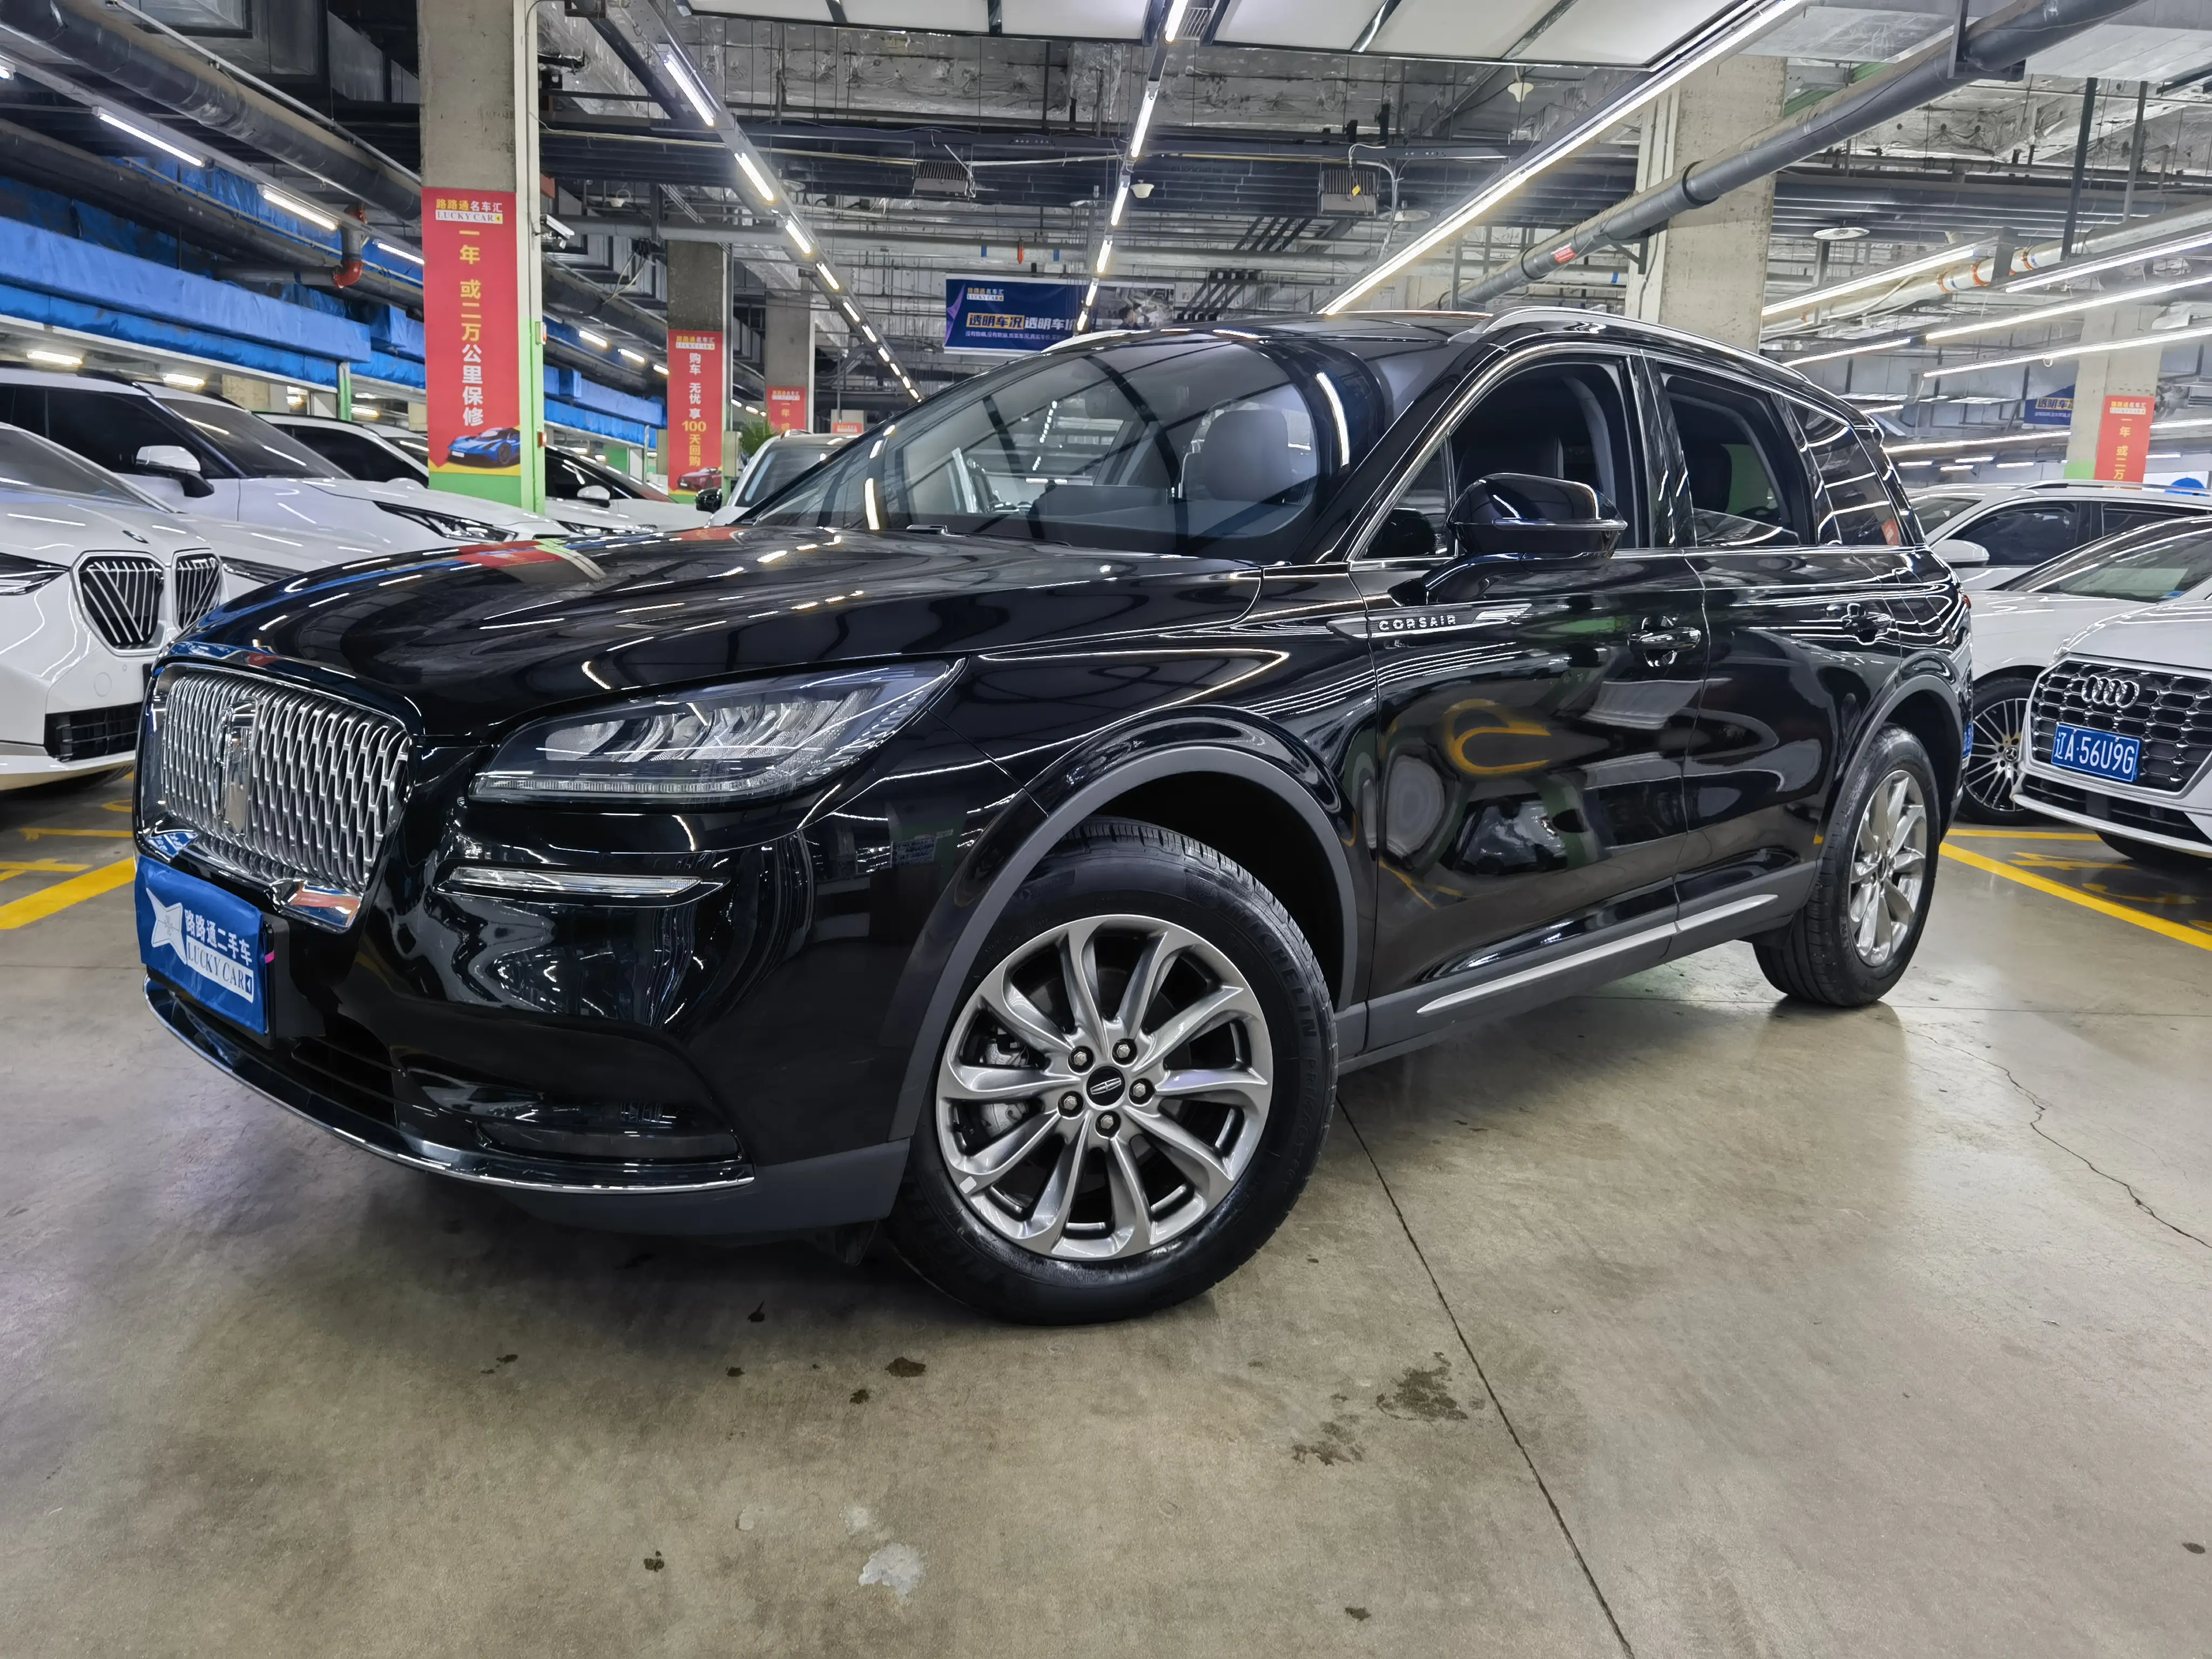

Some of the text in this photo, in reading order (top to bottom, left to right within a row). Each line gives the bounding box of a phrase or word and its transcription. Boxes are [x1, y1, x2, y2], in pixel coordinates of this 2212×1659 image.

[436, 198, 503, 213] 路路通名车汇
[437, 211, 494, 222] LUCKY CAR
[1379, 615, 1456, 631] CORSAIR
[184, 909, 253, 967] 路路通二手车
[187, 942, 245, 992] LUCKY CAR
[1224, 900, 1318, 1037] MICHELIN
